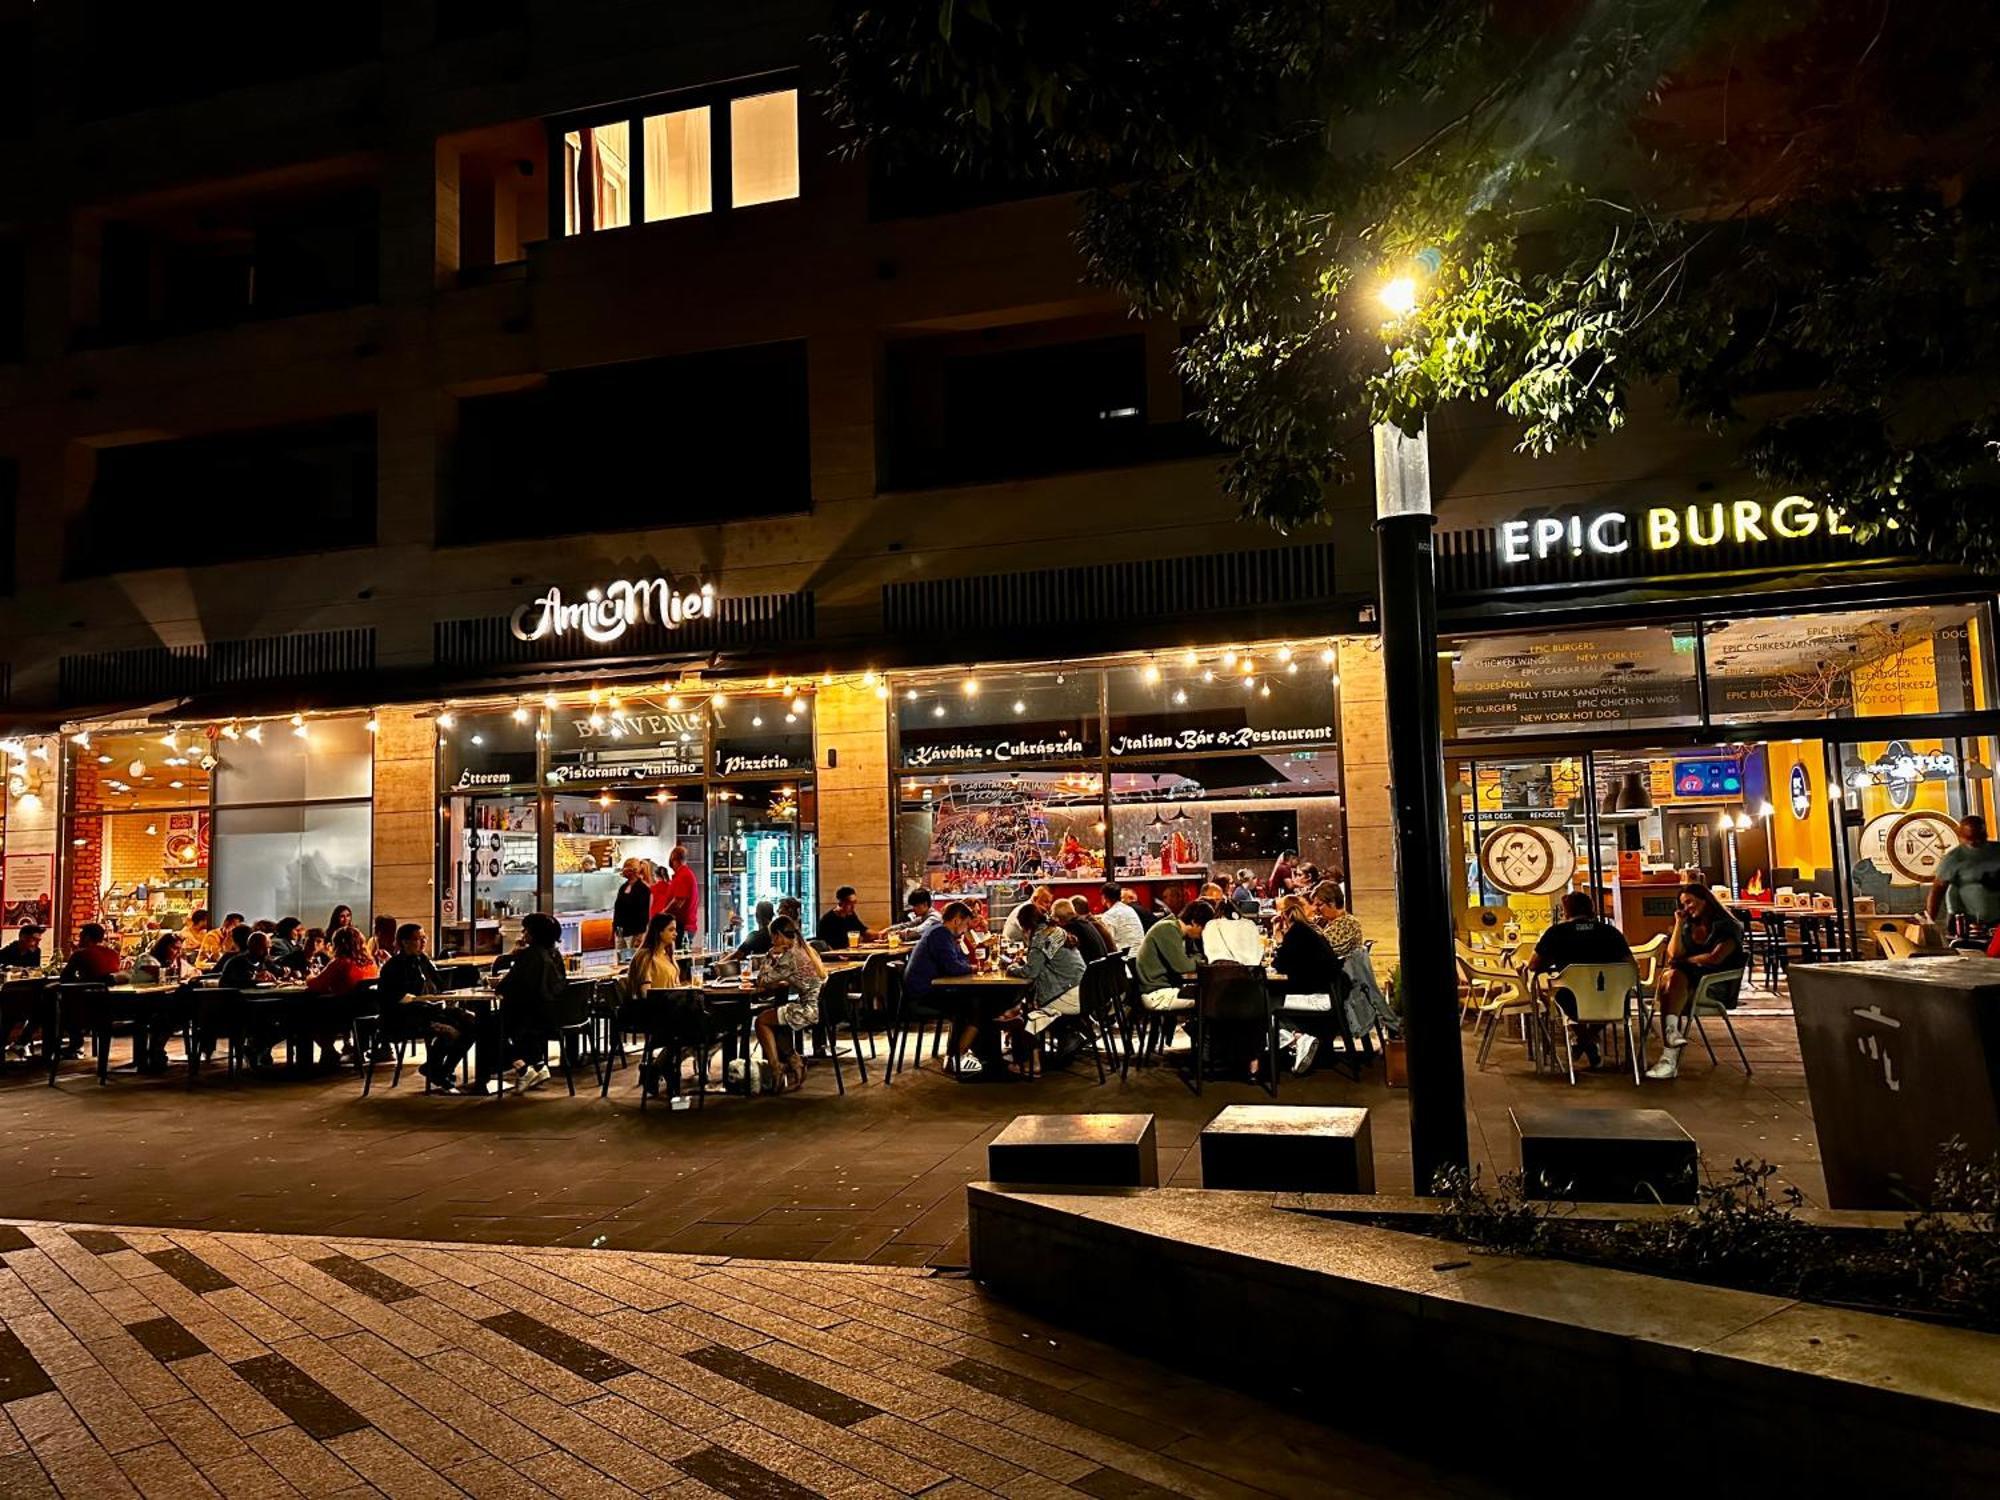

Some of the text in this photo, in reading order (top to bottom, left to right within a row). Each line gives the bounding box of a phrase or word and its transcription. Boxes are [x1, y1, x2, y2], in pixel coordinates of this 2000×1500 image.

[1503, 495, 1898, 563] EP!C BURGE
[607, 578, 715, 630] Miei
[1942, 631, 1968, 640] DOG
[1576, 653, 1599, 662] NEW
[1601, 651, 1626, 661] YORK
[1509, 686, 1626, 701] PHILLY STEAK SANDWICH
[1577, 695, 1680, 709] EPIC CHICKEN WINGS
[1726, 691, 1747, 700] EPIC
[1476, 703, 1518, 713] BURGERS
[1520, 710, 1621, 723] NEW YORK HOT DOG
[572, 709, 727, 739] BENVENUI
[1110, 735, 1172, 756] Italian
[1175, 730, 1215, 750] Bár
[1234, 727, 1333, 748] Restaurant
[908, 746, 983, 766] Kávéház
[995, 738, 1083, 761] Cukrászda
[552, 762, 697, 785] Ristorante Italiano
[724, 754, 789, 775] Pizzéria
[452, 768, 511, 792] Étterem
[1468, 812, 1492, 821] ODER
